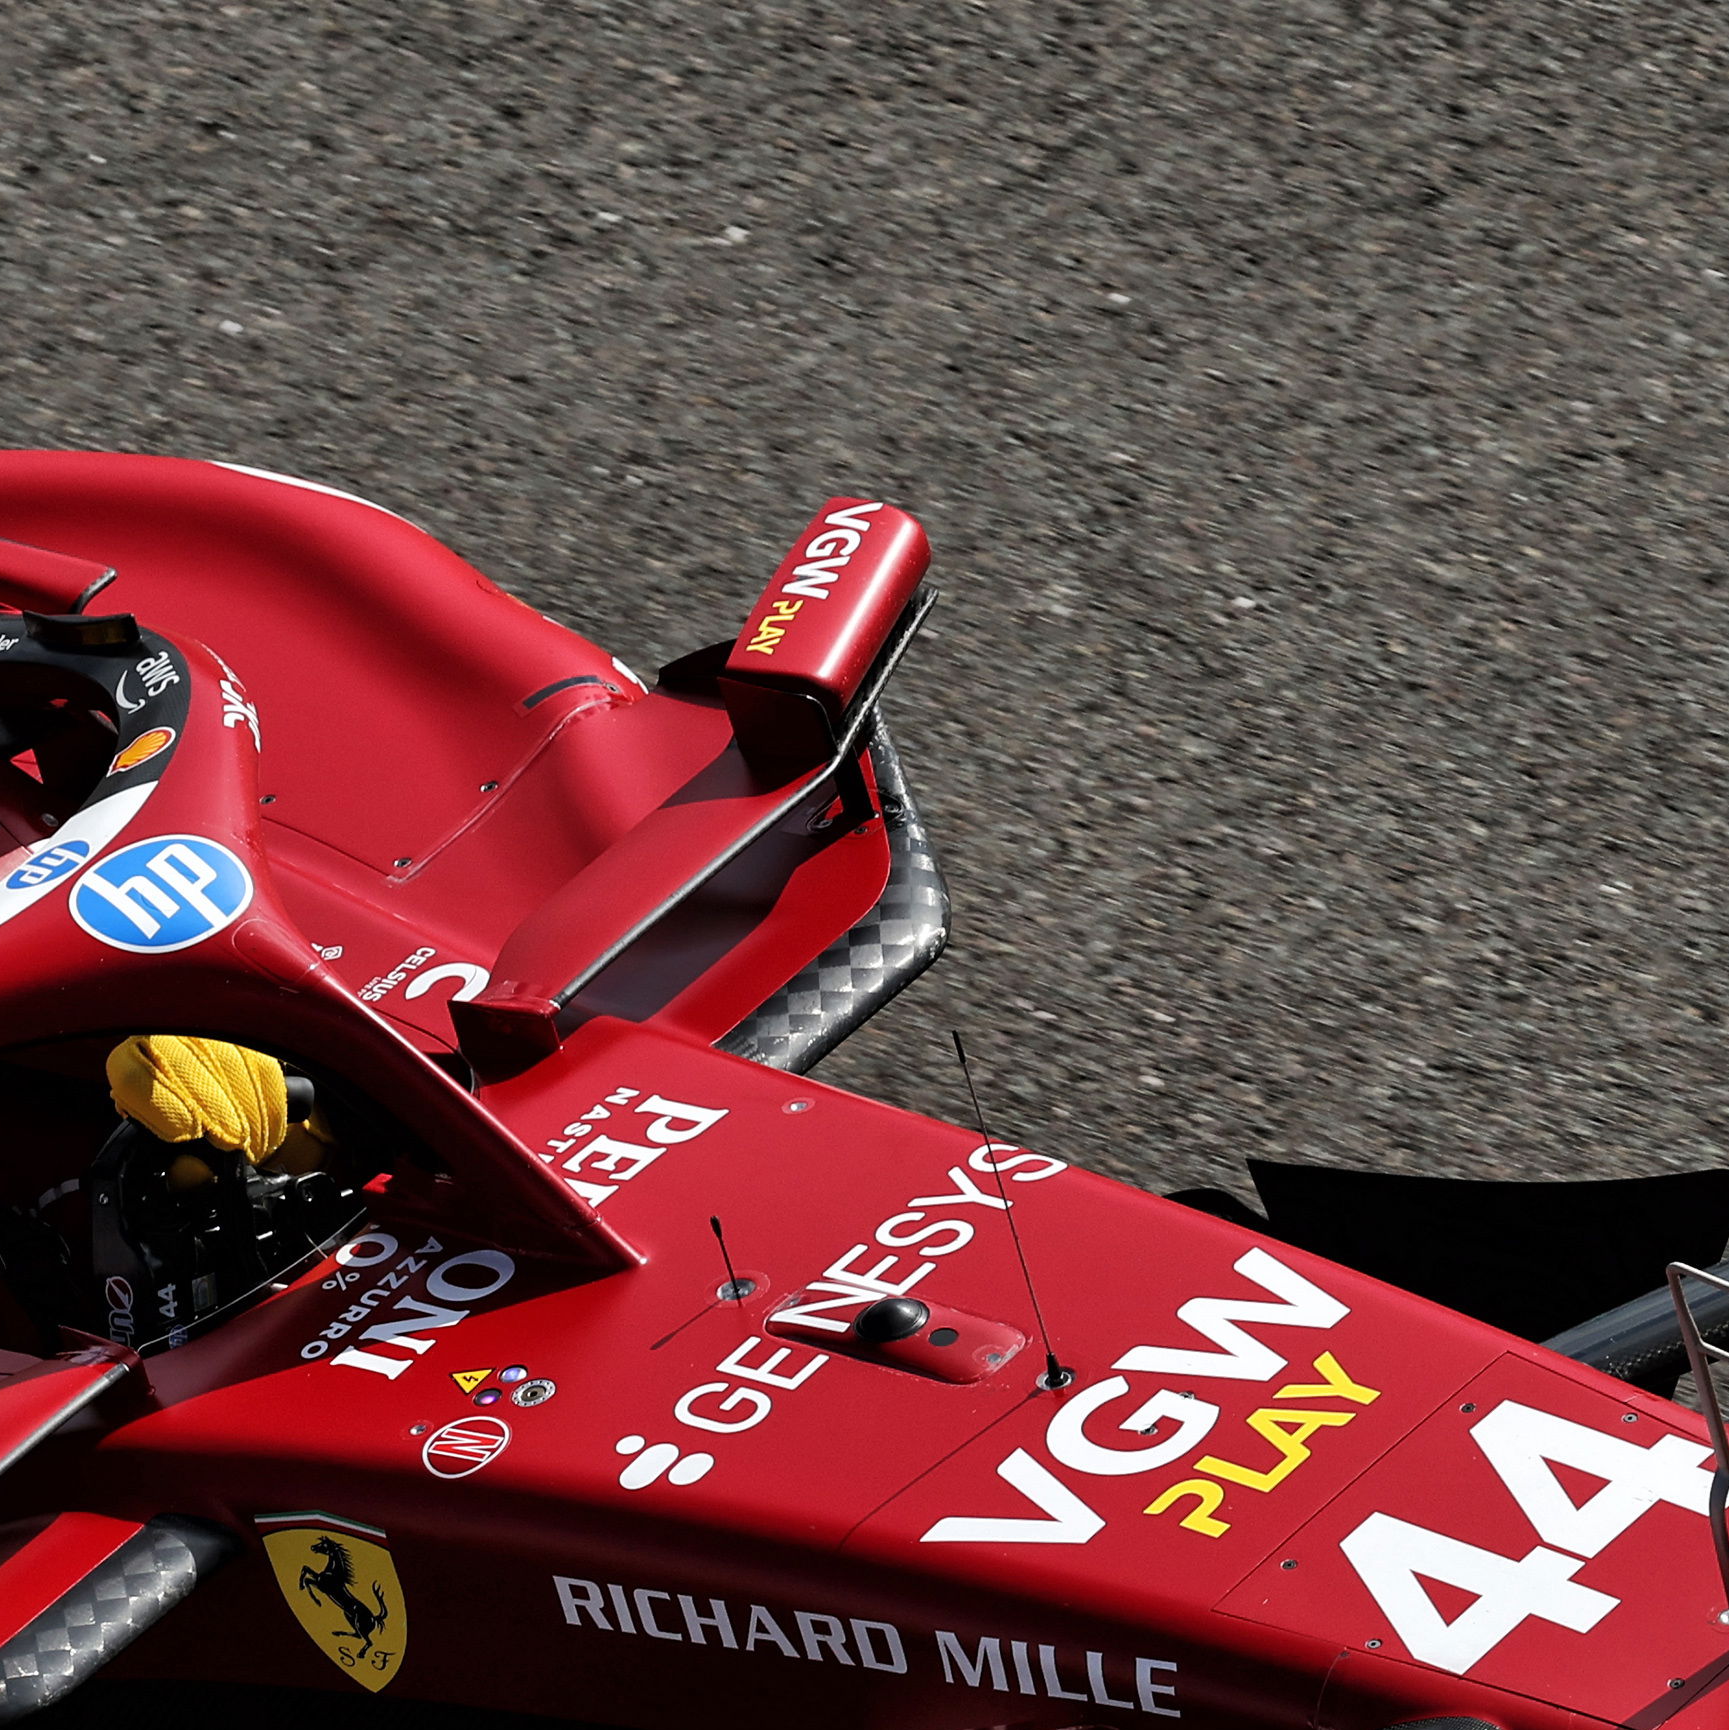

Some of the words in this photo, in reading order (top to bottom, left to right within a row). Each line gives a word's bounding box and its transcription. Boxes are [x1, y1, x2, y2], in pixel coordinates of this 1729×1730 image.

[781, 502, 884, 600] VGW
[135, 651, 181, 697] aws
[746, 599, 804, 656] PLAY
[80, 852, 240, 940] hp
[361, 946, 437, 1002] CELSIUS
[300, 1236, 444, 1360] AZZURRO
[674, 1143, 1069, 1434] GENESYS
[919, 1246, 1352, 1545] VGW
[1142, 1350, 1383, 1539] PLAY
[551, 1574, 909, 1676] RICHARD
[934, 1629, 1182, 1721] MILLE
